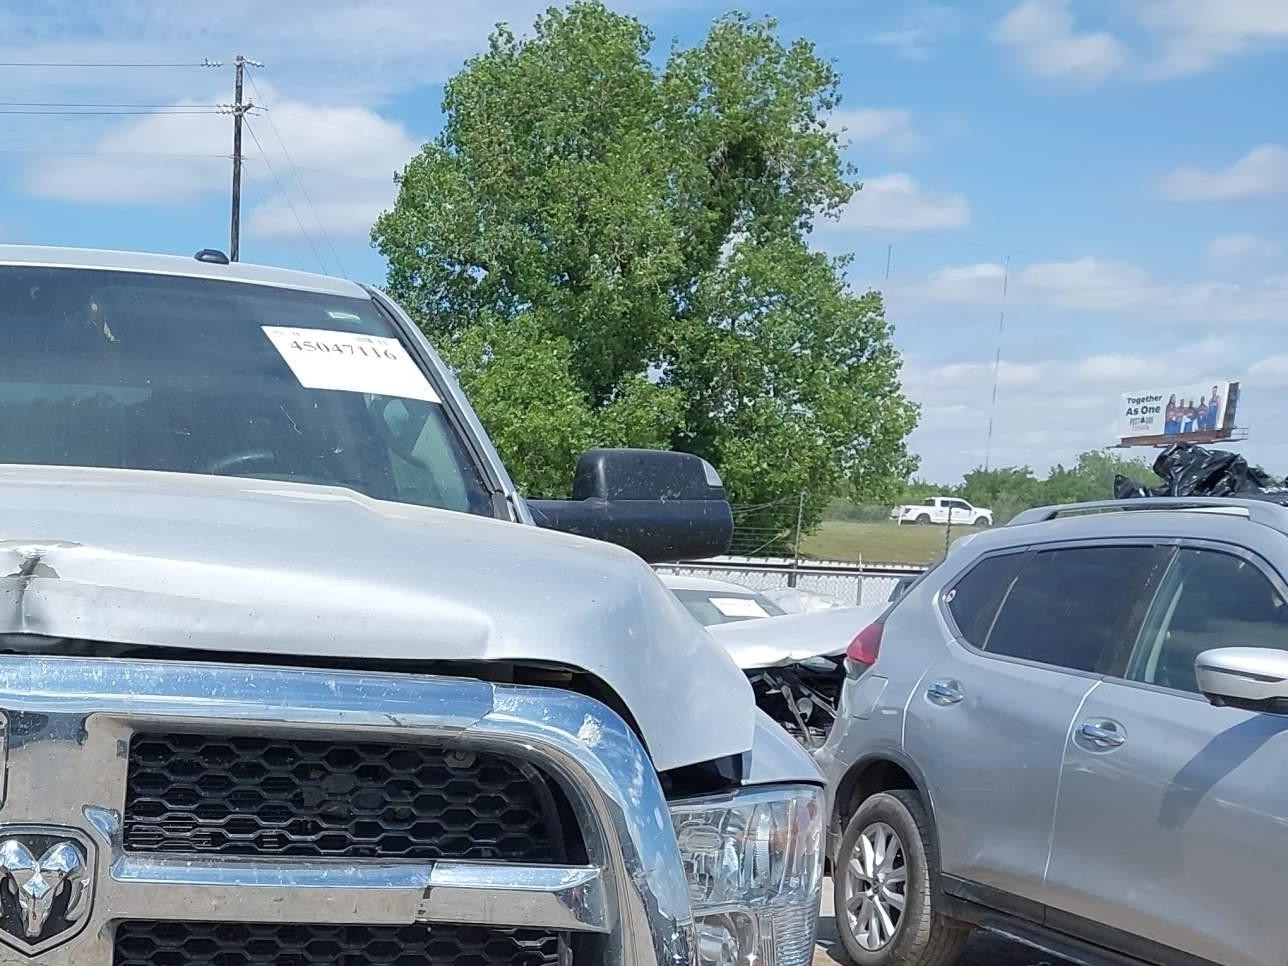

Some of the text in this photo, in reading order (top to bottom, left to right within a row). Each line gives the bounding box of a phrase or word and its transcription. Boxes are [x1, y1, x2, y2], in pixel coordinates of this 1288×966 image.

[290, 340, 398, 361] 45047116
[1126, 394, 1163, 405] Together
[1125, 405, 1161, 416] As One
